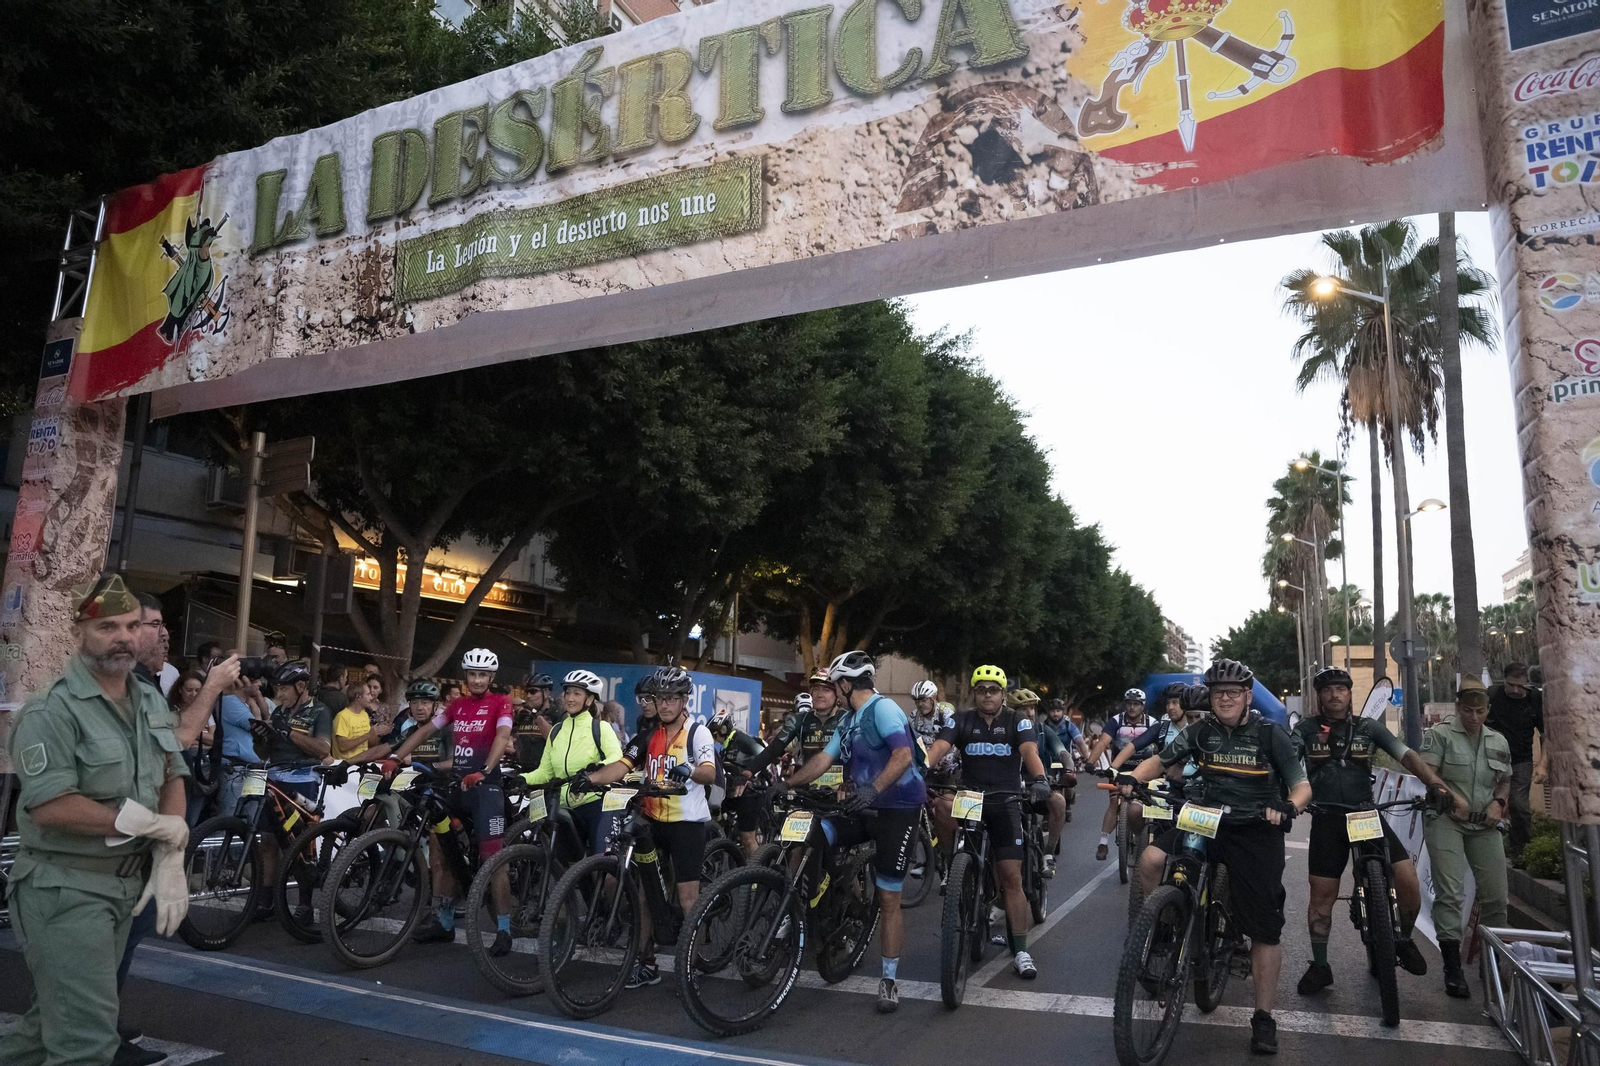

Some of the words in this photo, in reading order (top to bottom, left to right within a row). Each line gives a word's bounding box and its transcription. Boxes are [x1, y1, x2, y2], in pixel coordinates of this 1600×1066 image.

[1532, 0, 1599, 23] SENATOR
[251, 151, 347, 255] LA
[366, 0, 1031, 222] DESÉRTICA
[426, 249, 445, 274] La
[454, 231, 498, 268] Legión
[509, 233, 522, 257] y
[532, 223, 548, 250] el
[556, 211, 627, 245] desierto
[637, 204, 669, 228] nos
[680, 192, 717, 217] une
[30, 426, 57, 439] RENTA
[433, 581, 466, 596] CLUB
[965, 742, 1013, 757] wiber
[1213, 750, 1257, 766] DESÉRTICA
[1188, 809, 1218, 829] 10077
[896, 825, 913, 871] BICIMANIA
[776, 967, 799, 1005] MICHELIN
